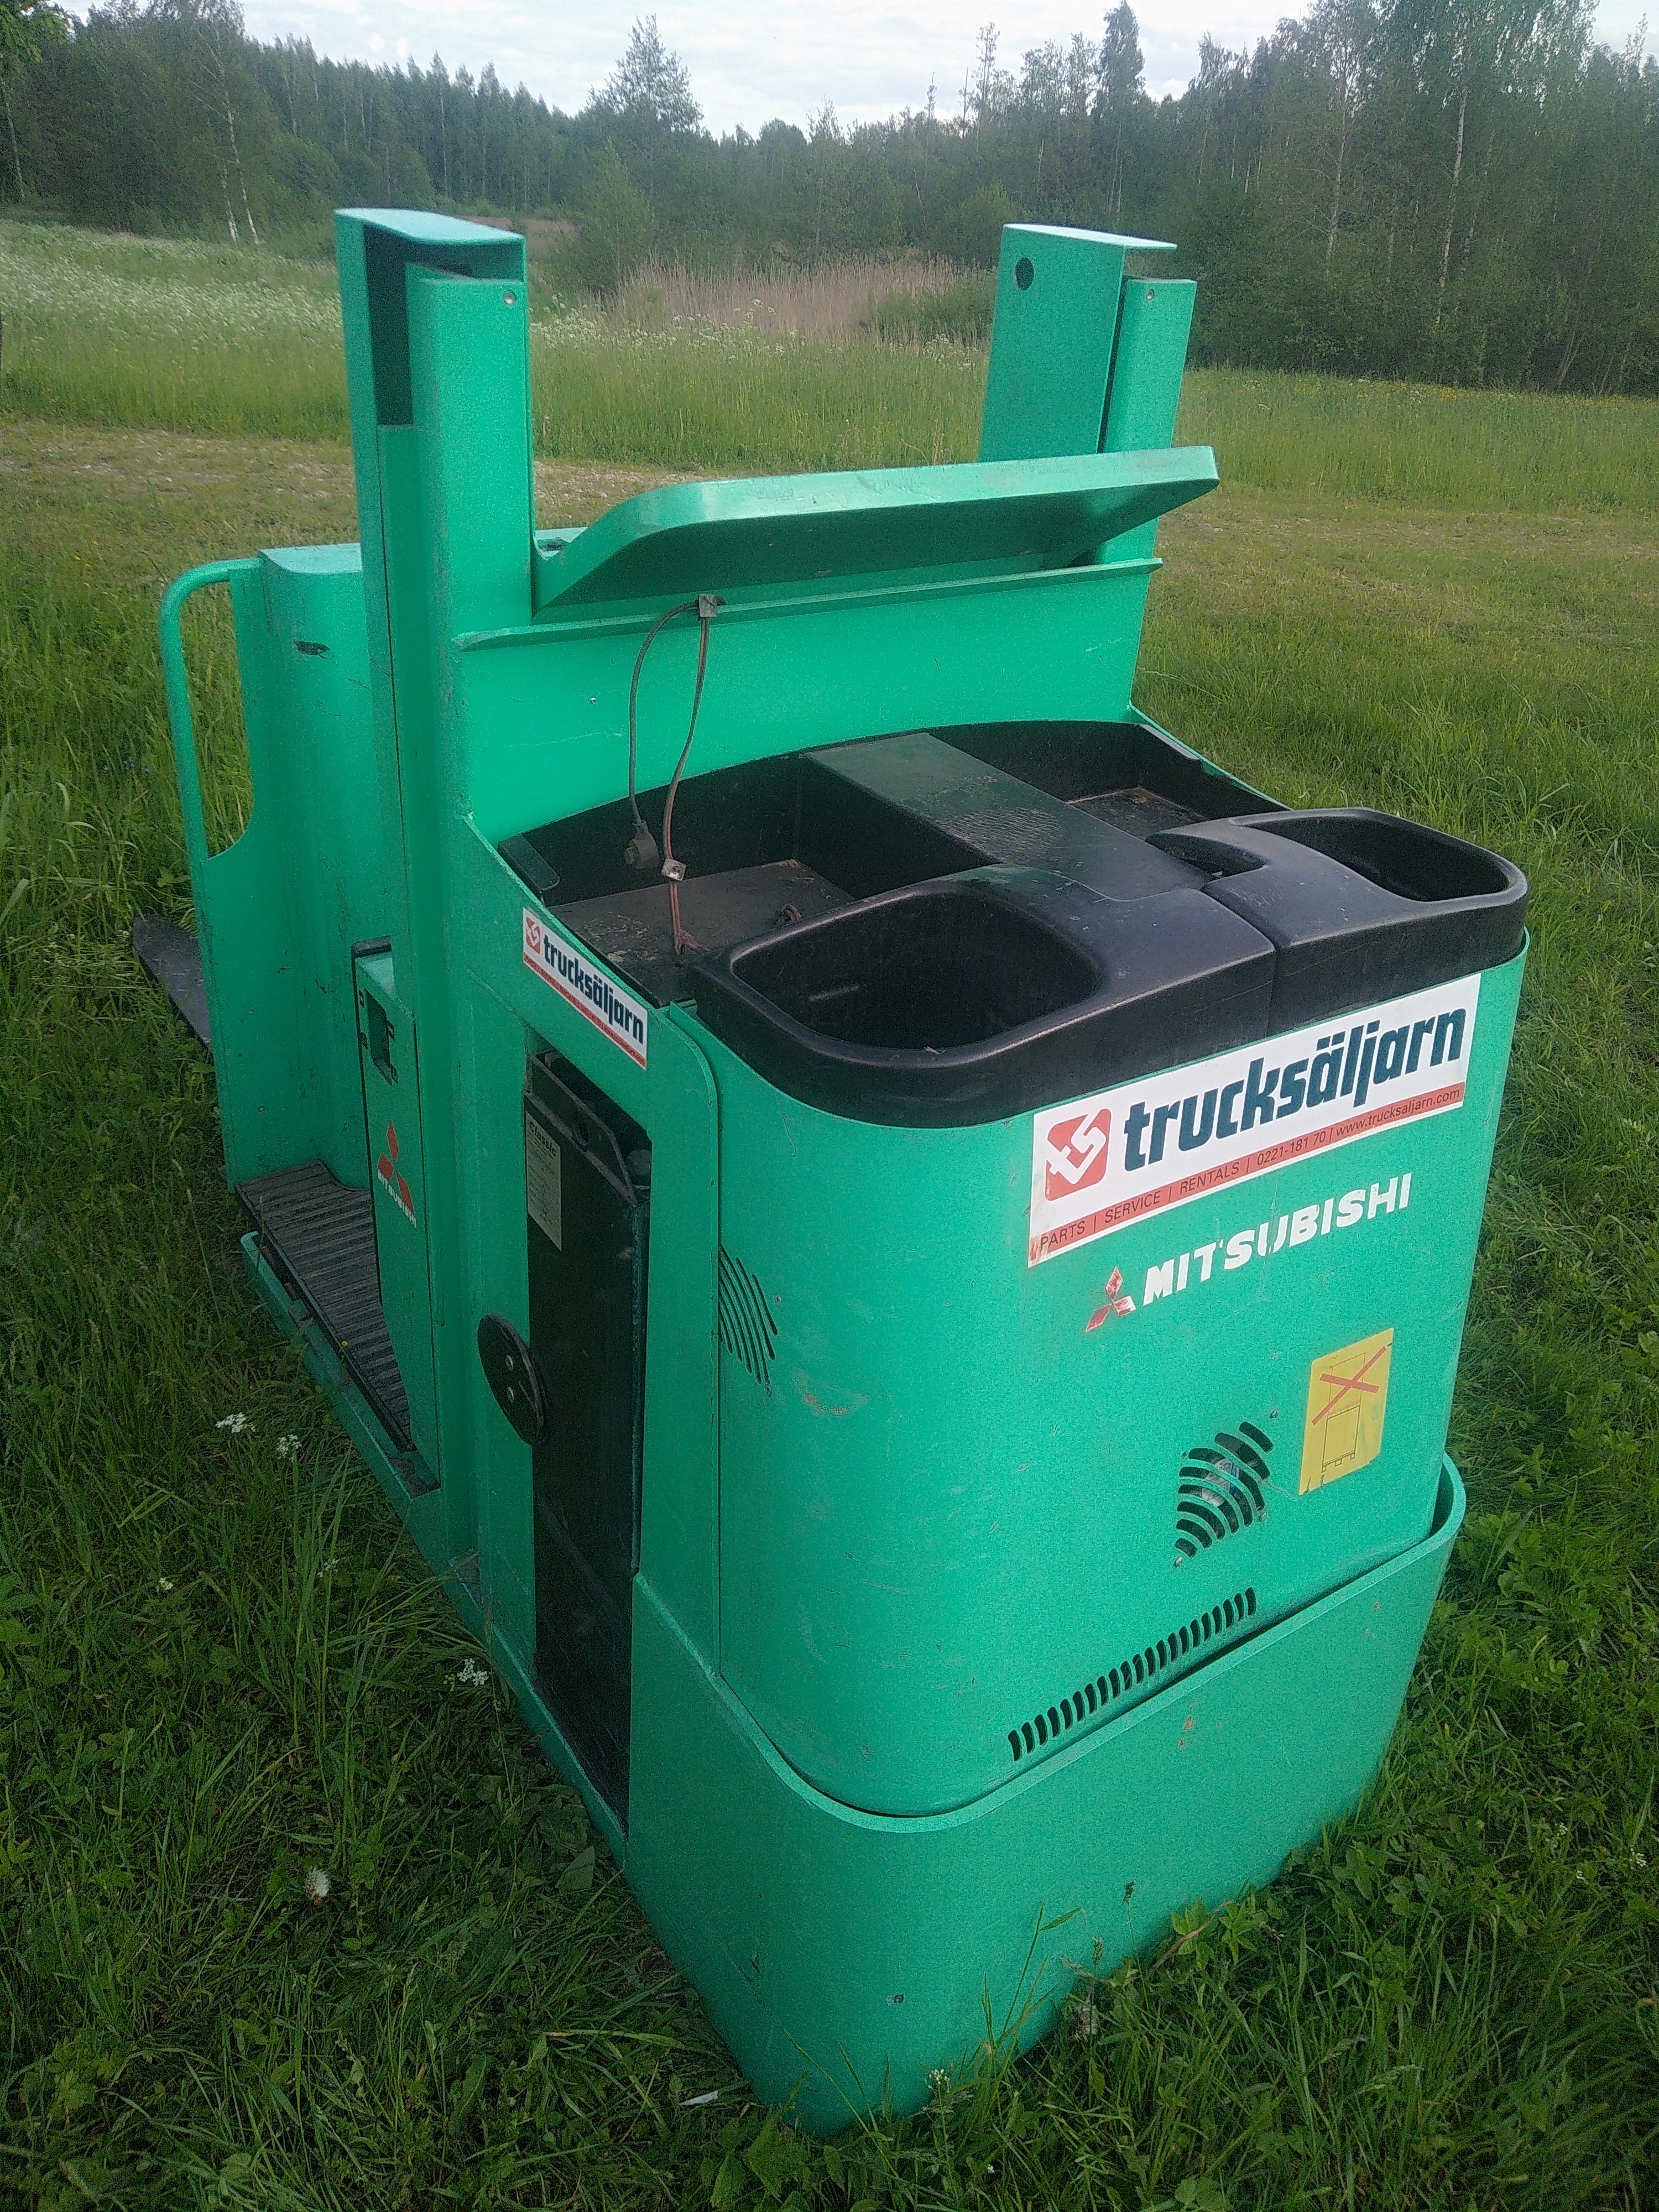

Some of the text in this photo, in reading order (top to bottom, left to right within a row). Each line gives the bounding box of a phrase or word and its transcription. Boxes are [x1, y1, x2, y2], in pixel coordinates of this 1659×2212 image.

[544, 933, 644, 1045] trucksäljarn
[529, 1120, 557, 1157] Classic
[1123, 1007, 1467, 1172] trucksäljarn
[1040, 1088, 1460, 1250] PARTS SERVICE RENTALS 0221-181 70 www.trucksaljarn.com
[1142, 1173, 1412, 1307] MITSUBISHI
